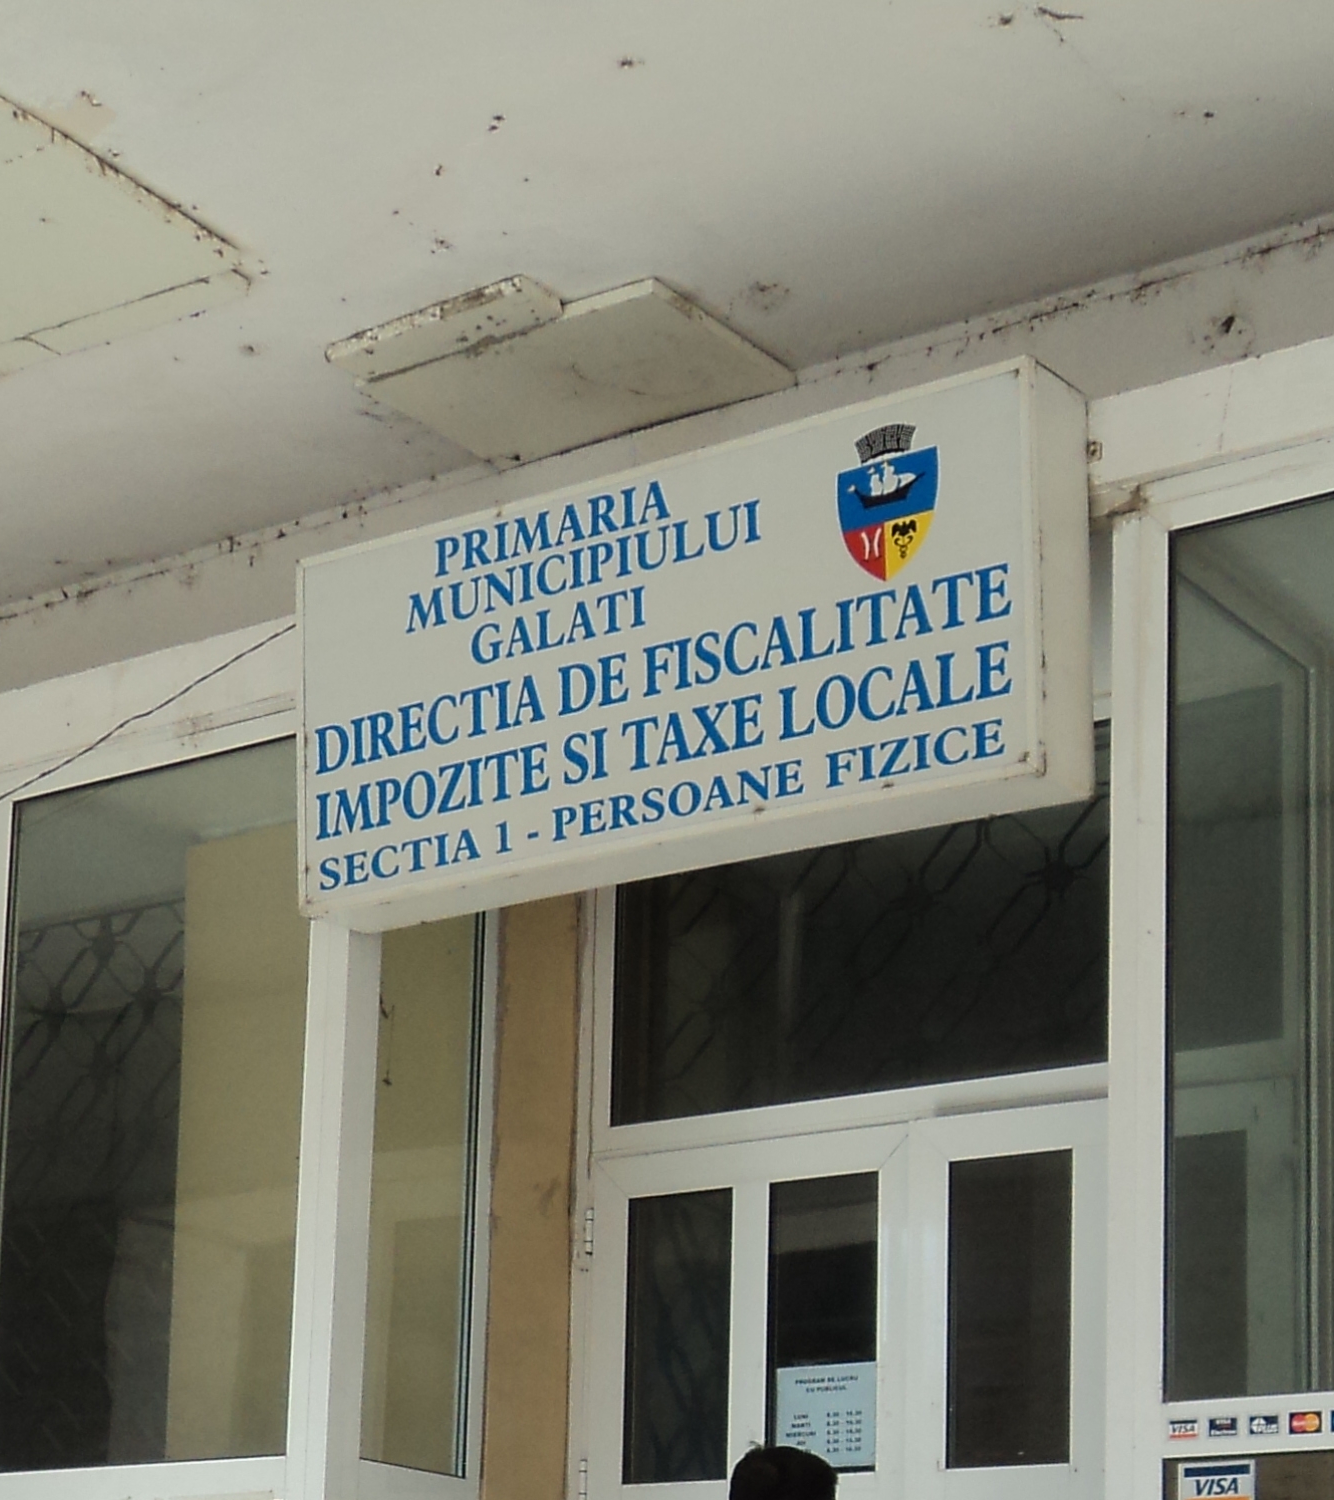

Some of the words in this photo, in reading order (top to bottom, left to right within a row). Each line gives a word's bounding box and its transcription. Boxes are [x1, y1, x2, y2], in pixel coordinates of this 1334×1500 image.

[405, 498, 762, 635] MUNICIPIULUI
[434, 480, 671, 579] PRIMARIA
[314, 674, 547, 777] DIRECTIA
[557, 651, 631, 718] DE
[643, 562, 1013, 699] FISCALITATE
[469, 584, 647, 666] GALATI
[315, 741, 551, 842] IMPOZITE
[561, 727, 609, 787] SI
[620, 692, 766, 773] TAXE
[777, 639, 1014, 742] LOCALE
[318, 828, 481, 892] SECTIA
[552, 761, 806, 843] PERSOANE
[825, 720, 1006, 790] FIZICE
[1172, 1424, 1196, 1433] VISA
[1194, 1477, 1239, 1496] VISA
